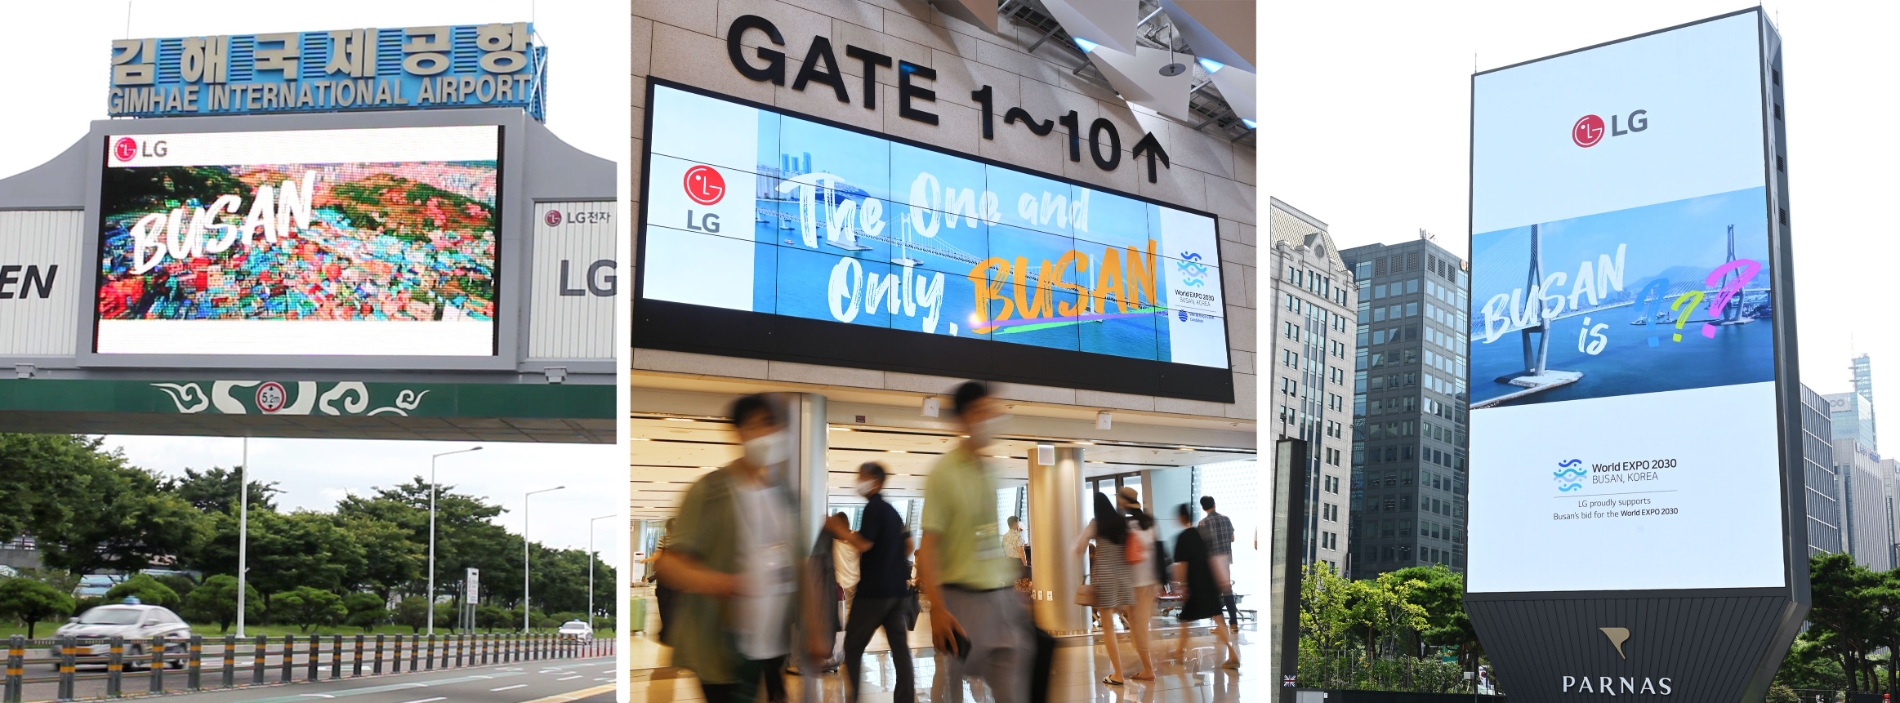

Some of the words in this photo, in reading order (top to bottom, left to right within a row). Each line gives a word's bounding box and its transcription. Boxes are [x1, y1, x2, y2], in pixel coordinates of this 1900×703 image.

[111, 22, 532, 85] 김해국제공항
[727, 14, 939, 126] GATE
[108, 85, 199, 114] GIMHAE
[207, 78, 408, 110] INTERNATIONAL
[417, 74, 531, 103] AIRPORT
[1611, 109, 1648, 137] LG
[142, 140, 168, 157] LG
[130, 170, 316, 275] BUSAN
[567, 212, 611, 224] LG전자
[686, 209, 721, 233] LG
[775, 171, 886, 249] The
[909, 172, 1002, 238] One
[1018, 186, 1091, 232] and
[967, 239, 1158, 335] BUSAN
[1481, 243, 1627, 344] BUSAN
[1578, 317, 1609, 355] is
[1592, 462, 1621, 473] World
[1623, 460, 1650, 471] EXPO
[1651, 458, 1677, 470] 2030
[1592, 474, 1625, 484] BUSAN,
[1627, 471, 1659, 482] KOREA
[1578, 500, 1588, 508] LG
[1590, 499, 1617, 509] proudly
[1618, 498, 1651, 507] supports
[1581, 511, 1592, 519] bid
[1594, 510, 1604, 518] for
[1609, 510, 1619, 518] the
[1620, 509, 1641, 517] World
[1641, 508, 1661, 516] EXPO
[1661, 507, 1679, 515] 2030
[1562, 675, 1672, 696] PARNAS
